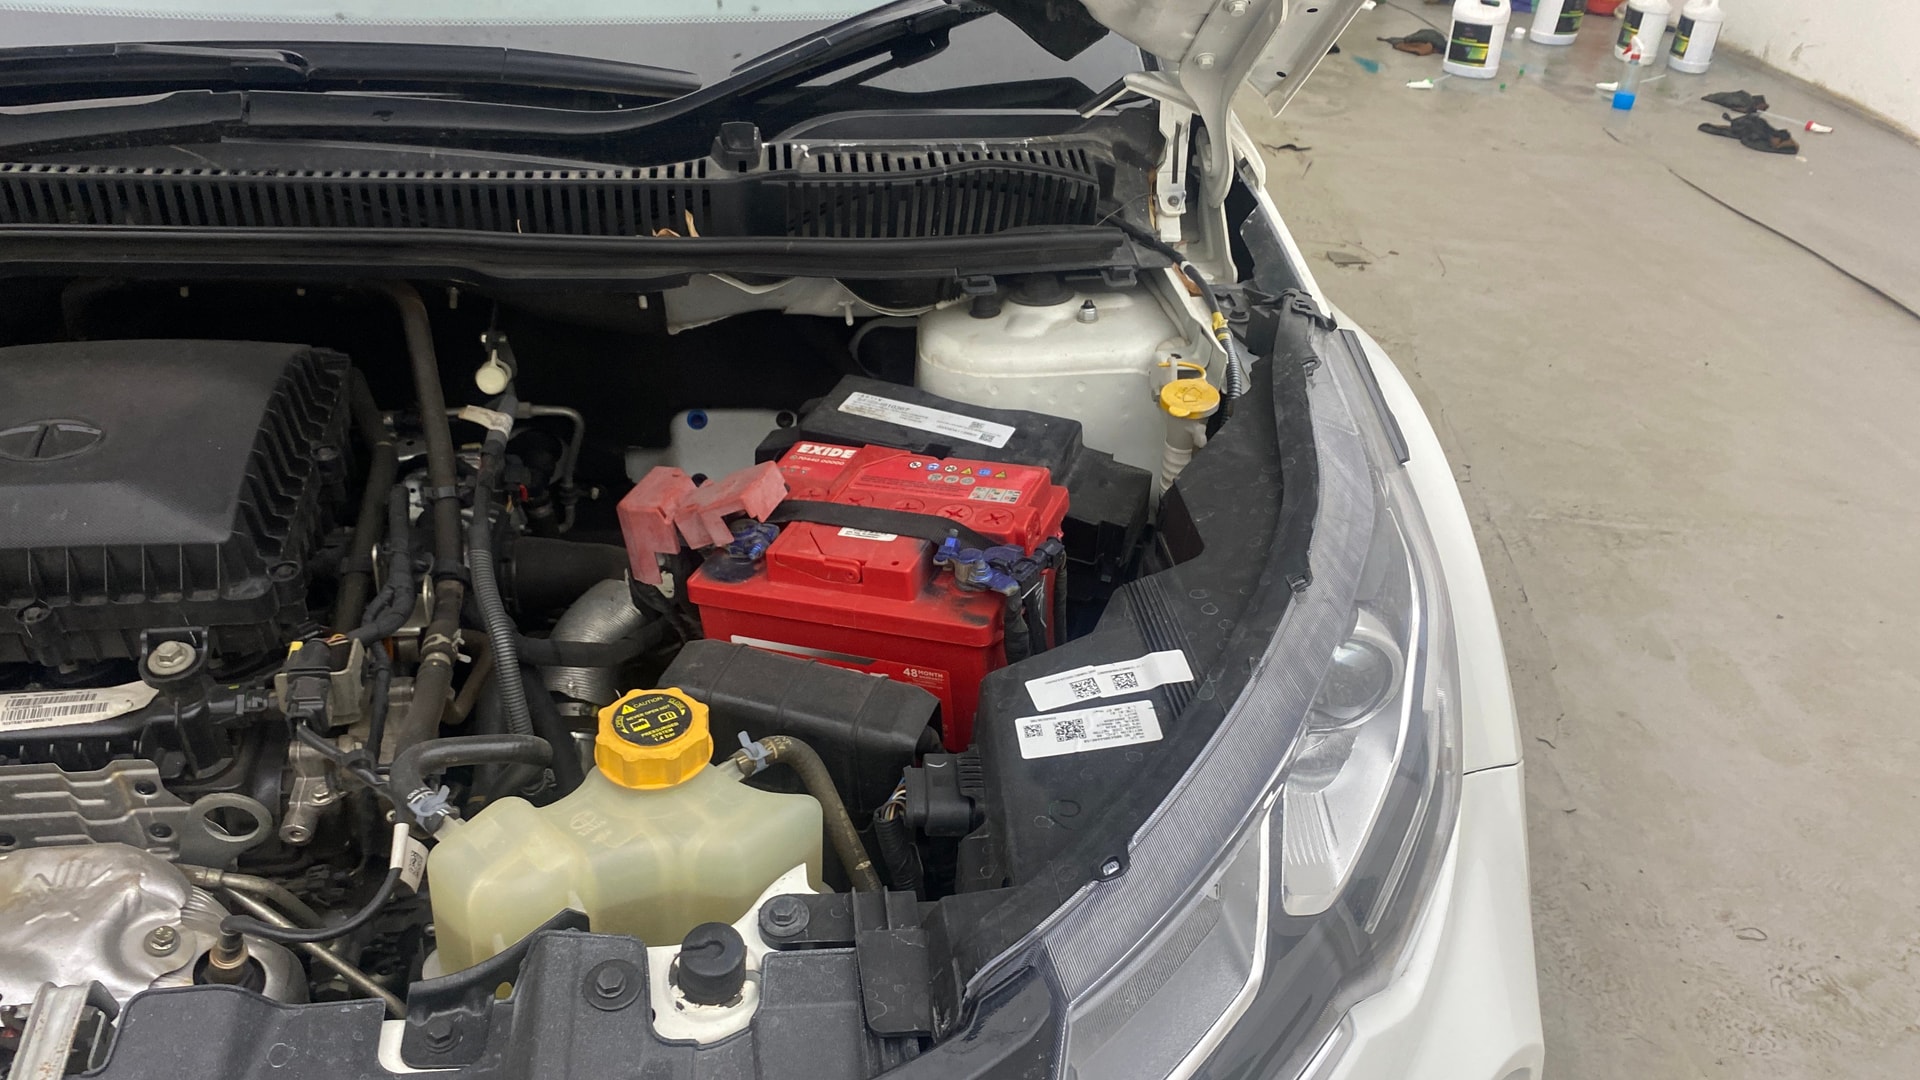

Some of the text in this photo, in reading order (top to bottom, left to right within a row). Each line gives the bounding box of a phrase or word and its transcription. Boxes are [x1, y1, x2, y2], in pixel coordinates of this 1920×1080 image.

[797, 443, 857, 459] EXIDE
[903, 667, 918, 678] 48
[918, 670, 944, 678] MONTH
[633, 696, 664, 708] CAUTION
[626, 713, 645, 721] NEVER
[651, 728, 674, 738] SYSTEM
